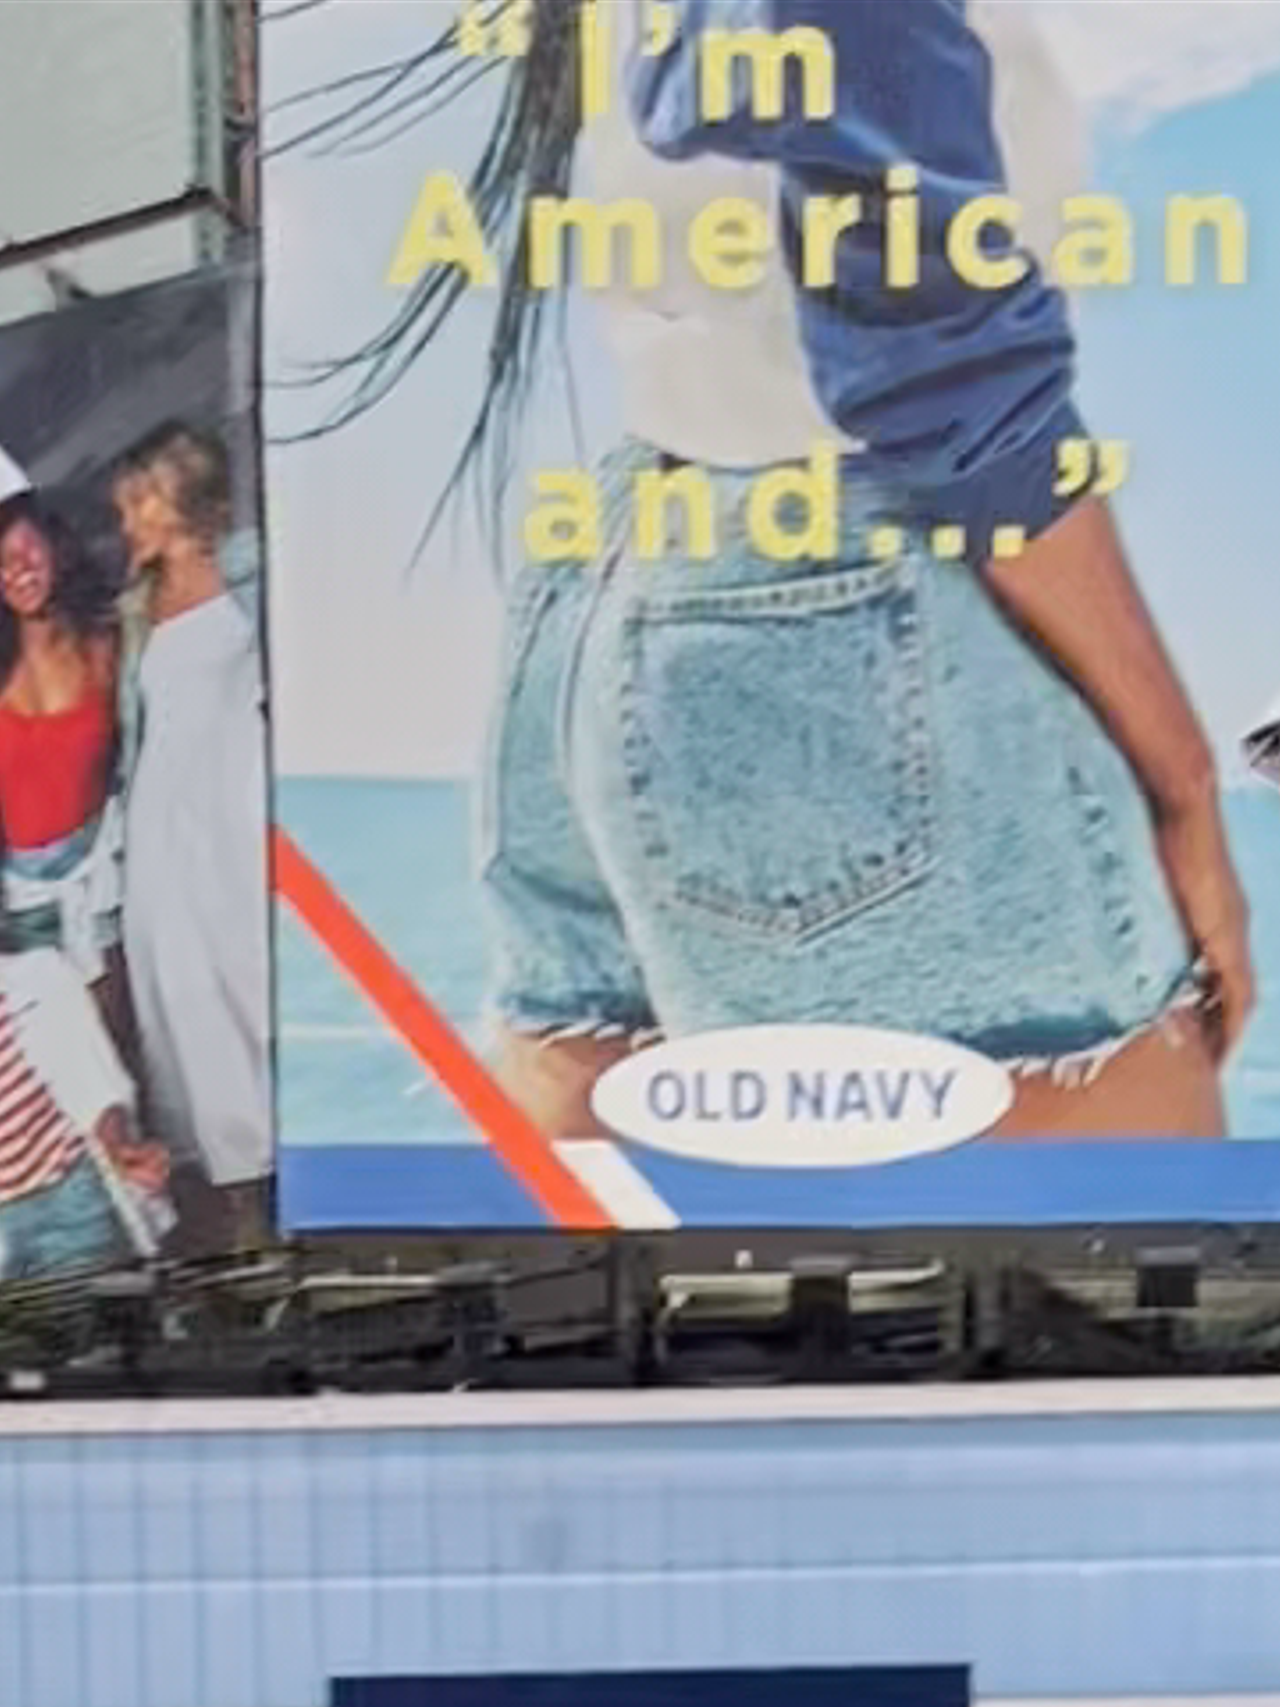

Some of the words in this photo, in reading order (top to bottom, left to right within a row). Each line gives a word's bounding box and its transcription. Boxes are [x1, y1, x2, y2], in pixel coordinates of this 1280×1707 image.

[387, 170, 1250, 290] American
[646, 1069, 767, 1123] OLD
[786, 1067, 958, 1122] NAVY
